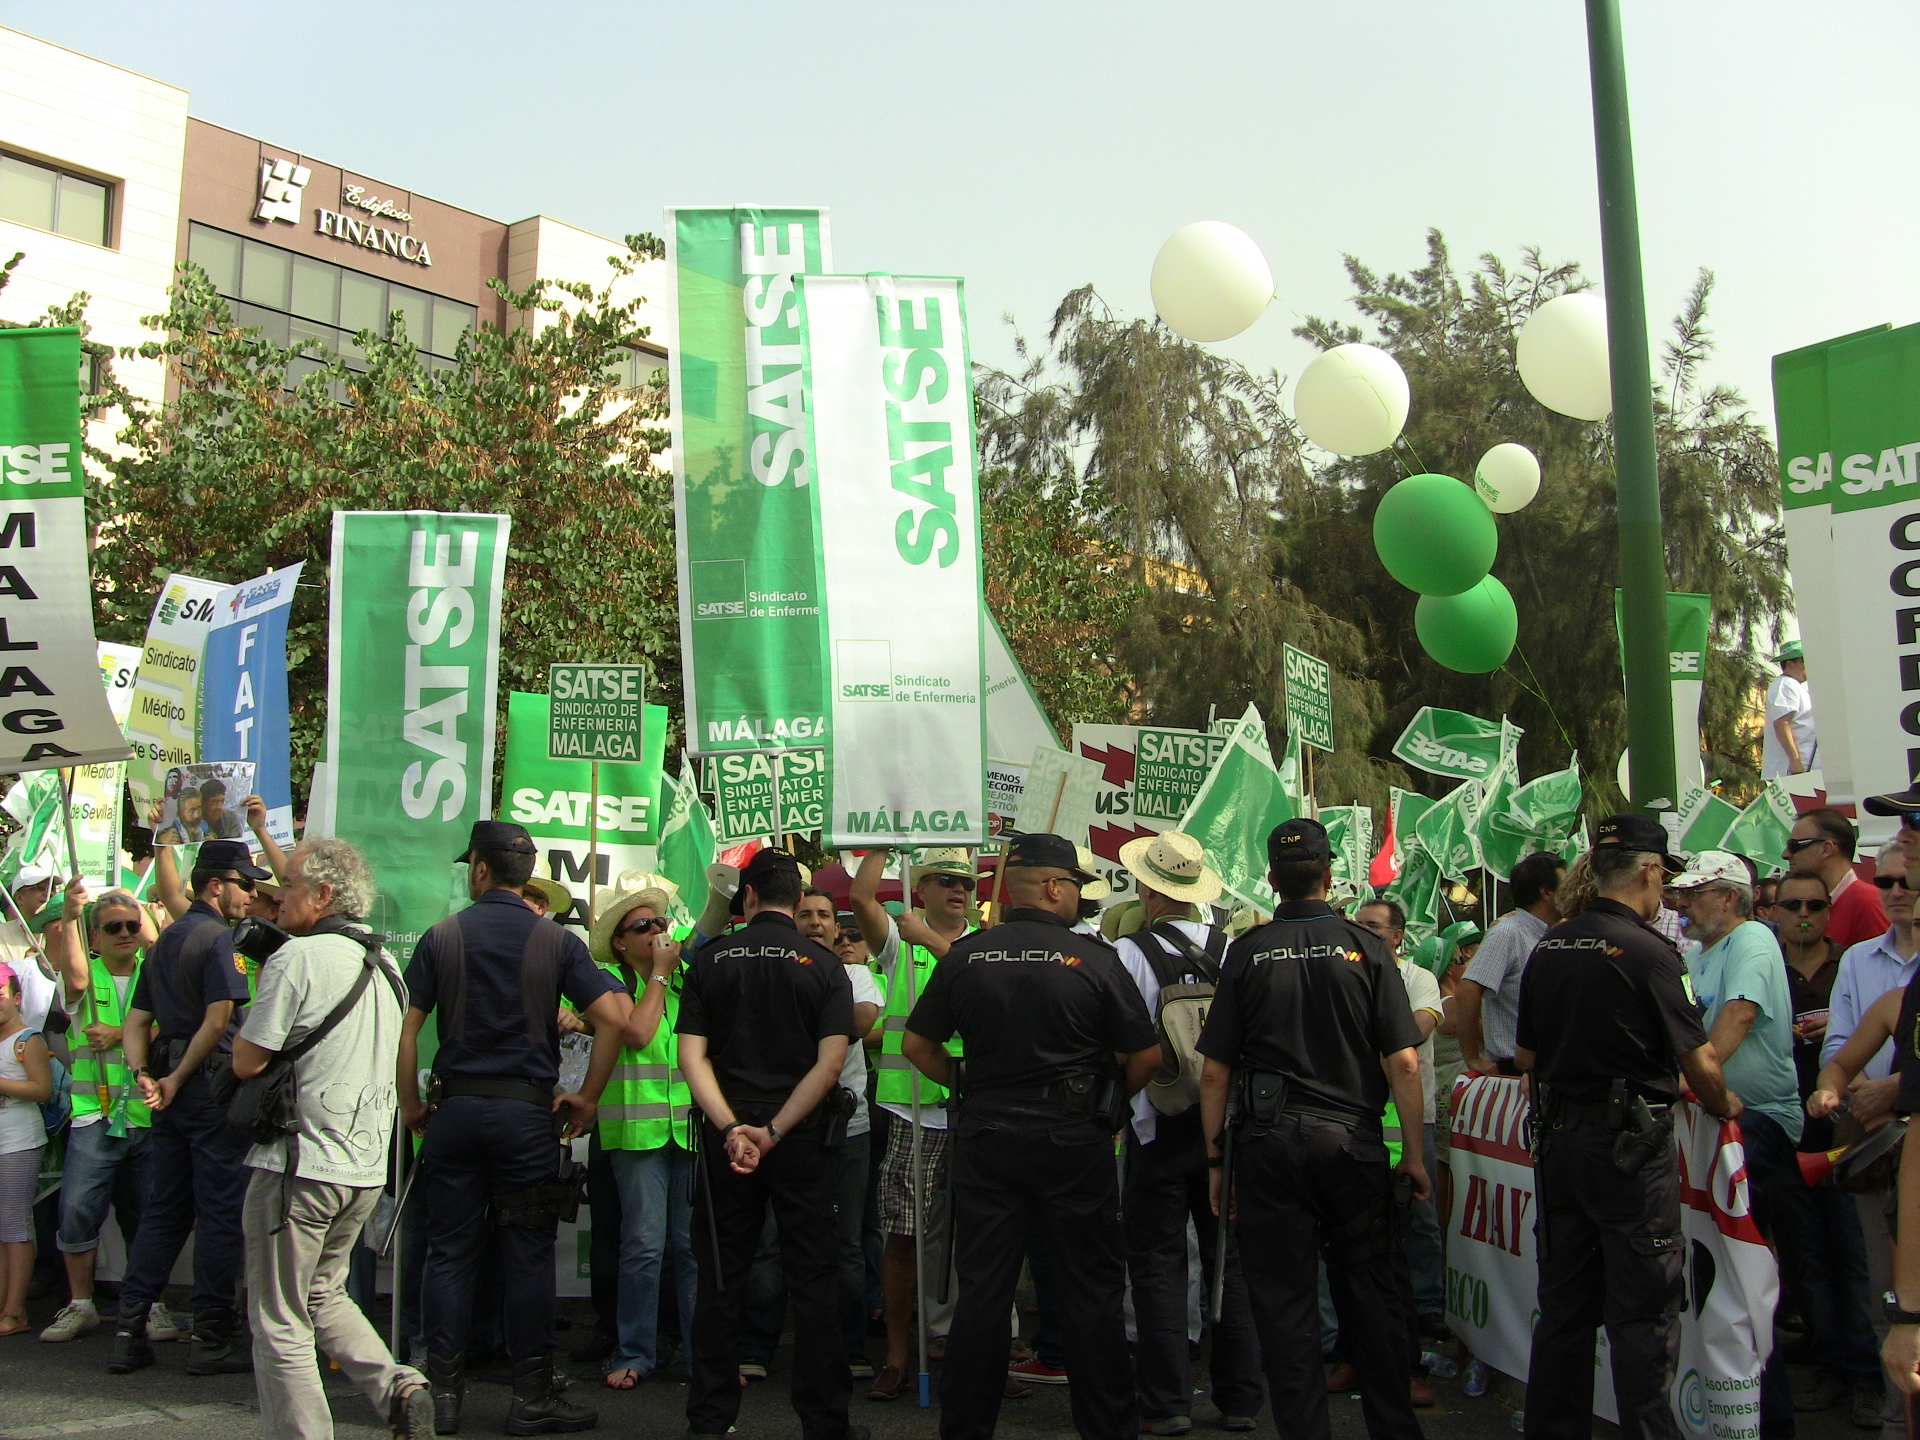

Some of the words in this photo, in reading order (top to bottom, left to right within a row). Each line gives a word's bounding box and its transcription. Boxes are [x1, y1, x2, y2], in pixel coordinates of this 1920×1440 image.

[344, 184, 413, 222] Edificio
[317, 208, 432, 266] FINANCA
[741, 222, 810, 489] SATSE
[876, 295, 960, 569] SATSE
[749, 590, 807, 603] Sindicato
[697, 601, 744, 615] SATSE
[750, 604, 765, 617] de
[145, 647, 196, 673] Sindicato
[401, 530, 480, 822] SATSE
[894, 674, 950, 688] Sindicato
[1286, 650, 1328, 695] SATSE
[553, 669, 639, 701] SATSE
[842, 684, 890, 698] SATSE
[1287, 681, 1319, 705] SINDICATO
[1319, 695, 1328, 709] DE
[895, 690, 910, 703] de
[913, 691, 976, 704] Enfermería
[142, 697, 186, 722] Médico
[553, 701, 617, 717] SINDICATO
[620, 703, 638, 718] DE
[1288, 695, 1330, 723] ENFERMERIA
[553, 717, 638, 732] ENFERMERIA
[708, 715, 824, 742] MÁLAGA
[1289, 710, 1331, 746] MALAGA
[149, 744, 191, 766] Sevilla
[552, 732, 637, 759] MALAGA
[1140, 733, 1223, 768] SATSE
[1139, 763, 1201, 782] SINDICATO
[987, 781, 1024, 794] ECORTE
[81, 803, 113, 820] Sevilla
[509, 787, 650, 832] SATSE
[846, 806, 970, 834] MÁLAGA
[1280, 835, 1301, 844] CNP
[1600, 825, 1617, 833] CNP
[107, 859, 114, 872] El
[714, 945, 798, 964] POLICIA
[1252, 945, 1349, 966] POLICIA
[1535, 937, 1608, 953] POLICIA
[968, 949, 1066, 965] POLICIA
[1460, 1174, 1532, 1257] HAY
[1653, 1236, 1673, 1248] CNP
